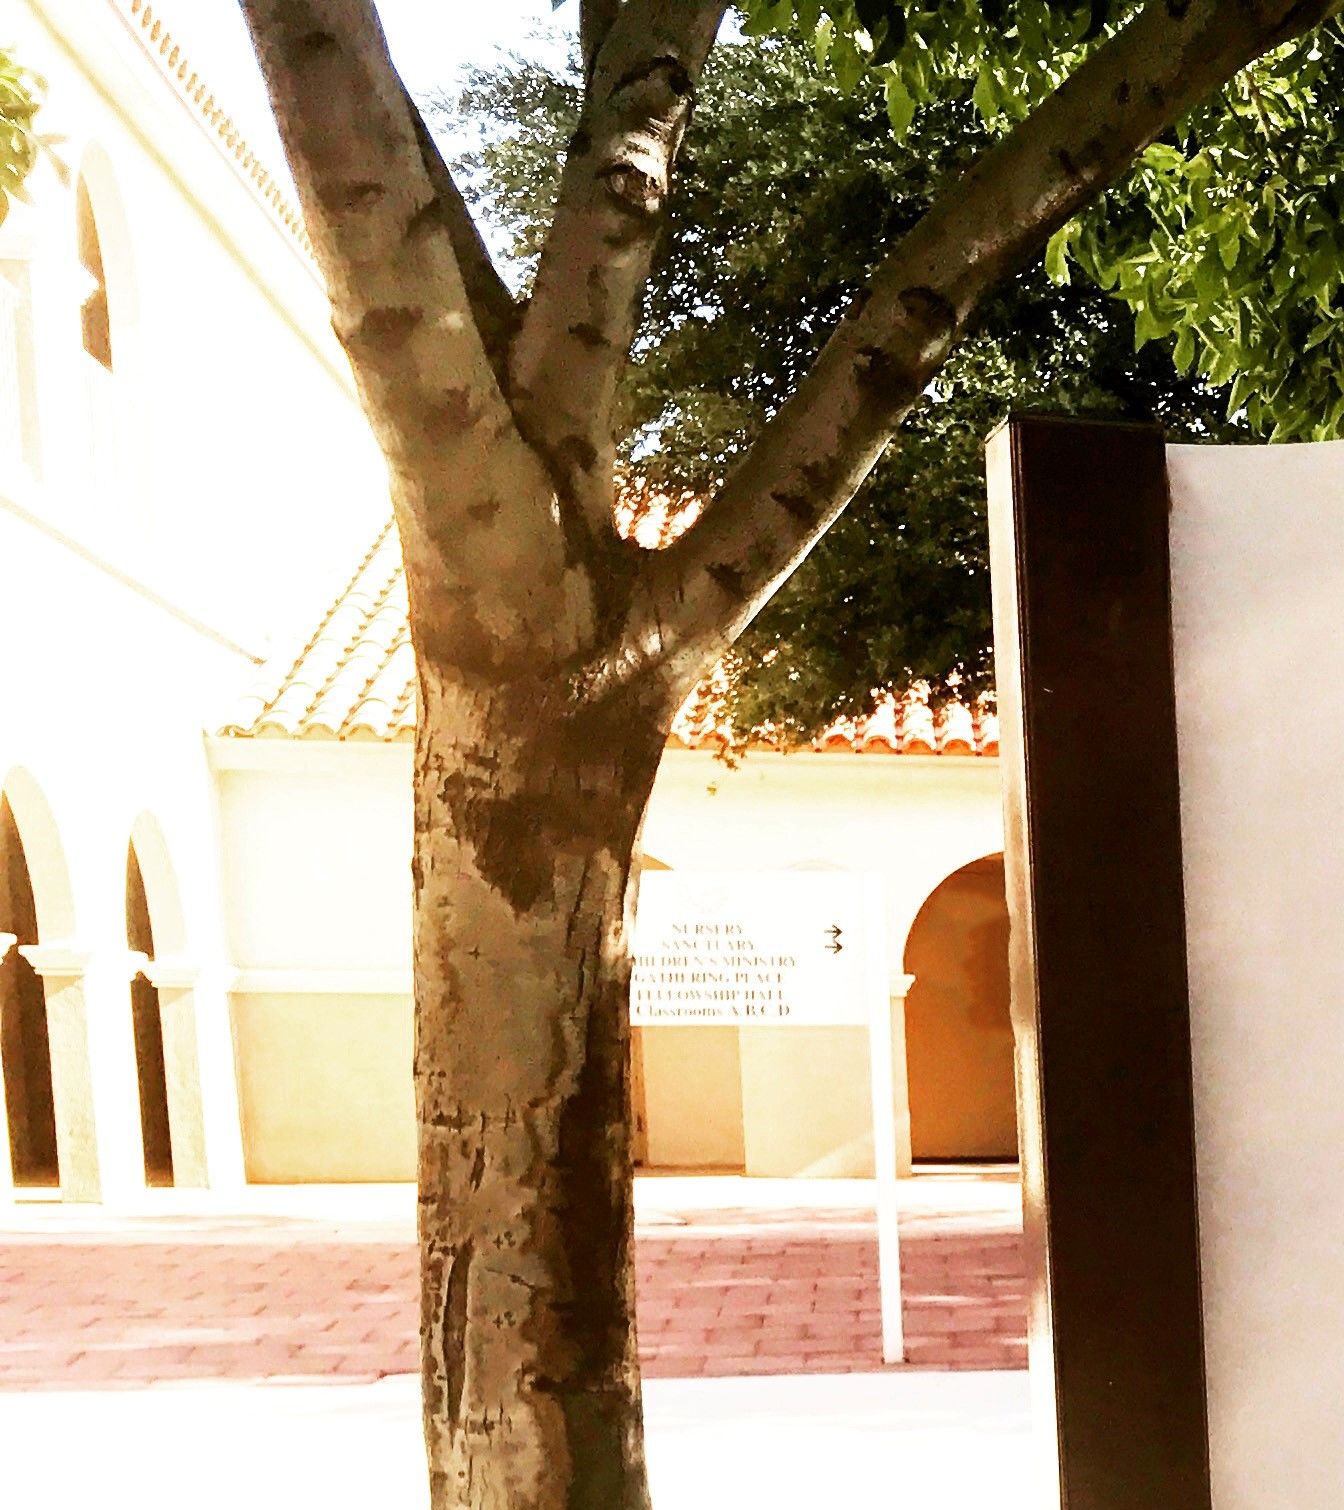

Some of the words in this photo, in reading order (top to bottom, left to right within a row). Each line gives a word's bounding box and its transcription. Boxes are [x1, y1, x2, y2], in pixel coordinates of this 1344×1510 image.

[634, 972, 730, 983] GATHERING
[735, 972, 784, 983] PLACE
[636, 1005, 723, 1016] Classrooms
